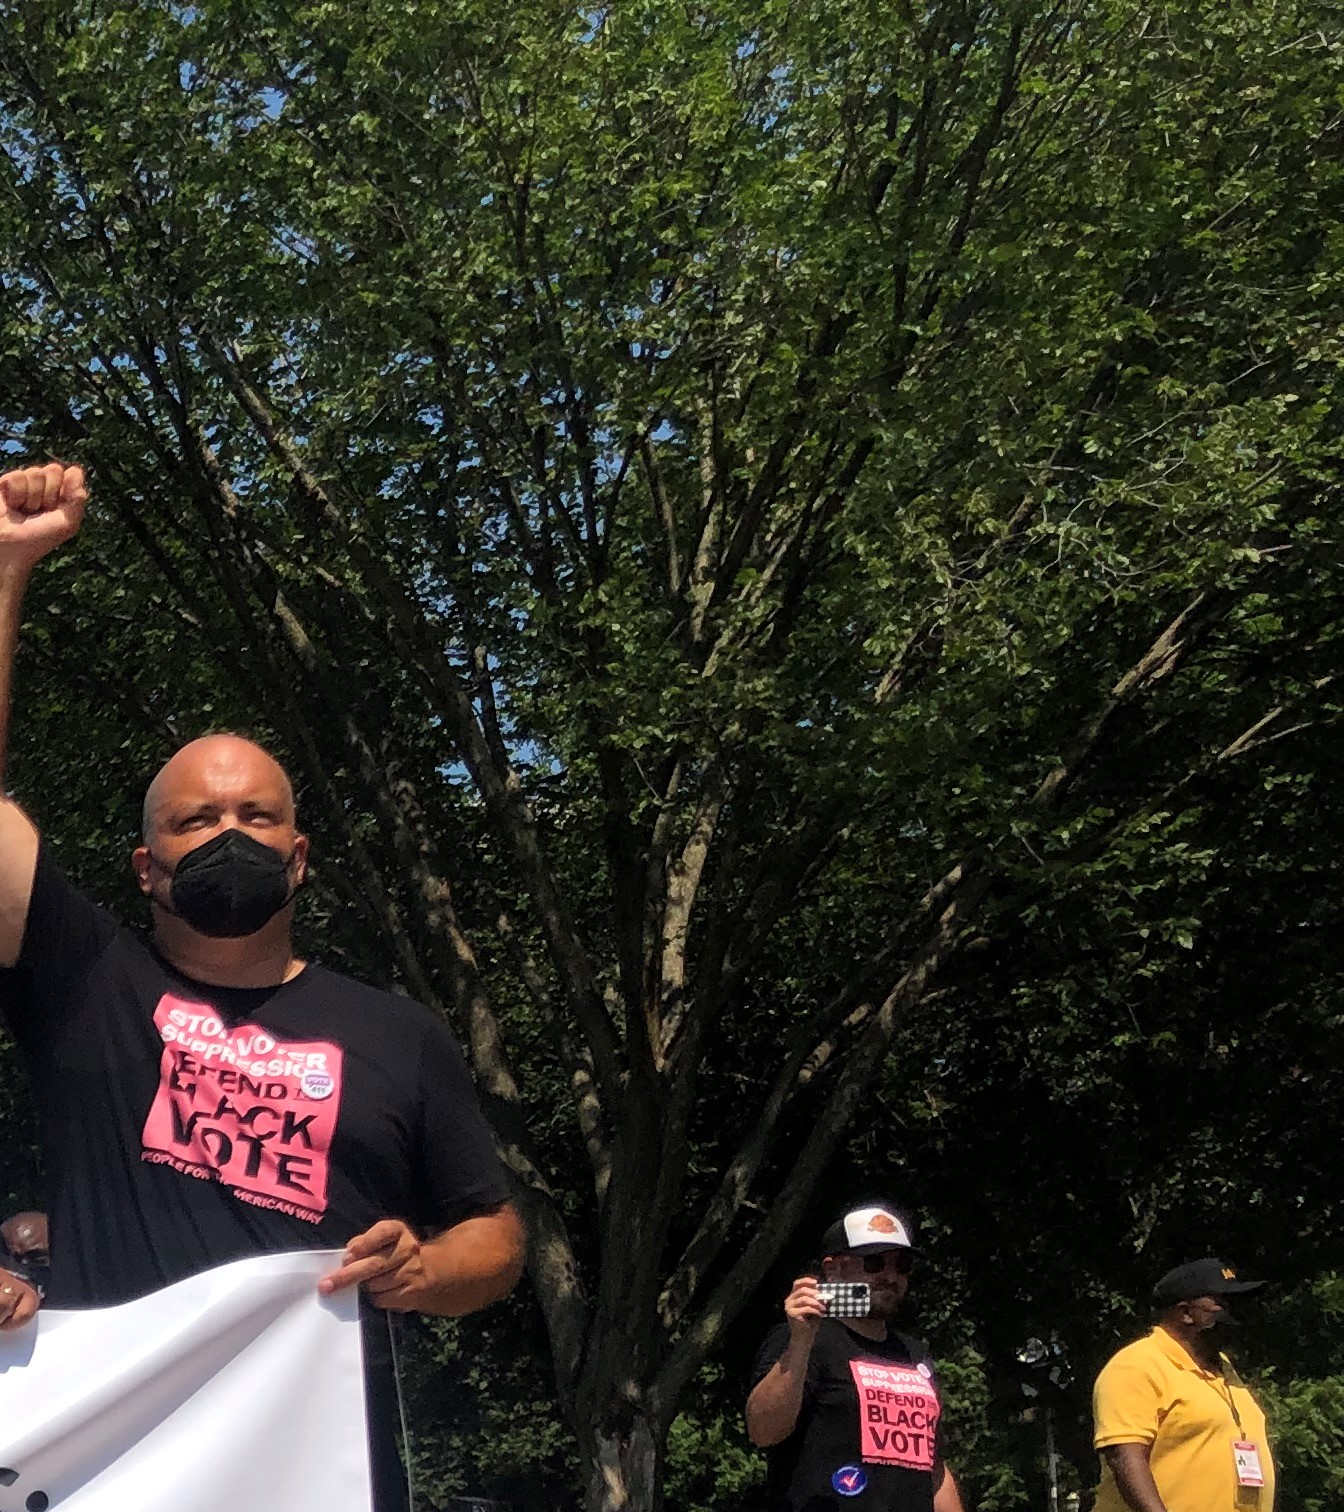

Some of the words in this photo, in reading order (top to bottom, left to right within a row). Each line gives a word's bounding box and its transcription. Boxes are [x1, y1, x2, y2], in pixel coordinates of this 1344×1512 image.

[167, 1008, 228, 1041] STO
[162, 1023, 308, 1079] SUPPRESSIO
[169, 1095, 315, 1197] VOTE
[233, 1188, 295, 1217] MERICAN
[295, 1205, 325, 1226] WAY
[857, 1365, 889, 1380] STOP
[890, 1371, 929, 1385] VOTE
[865, 1389, 926, 1409] DEFEND
[867, 1403, 936, 1432] BLACK
